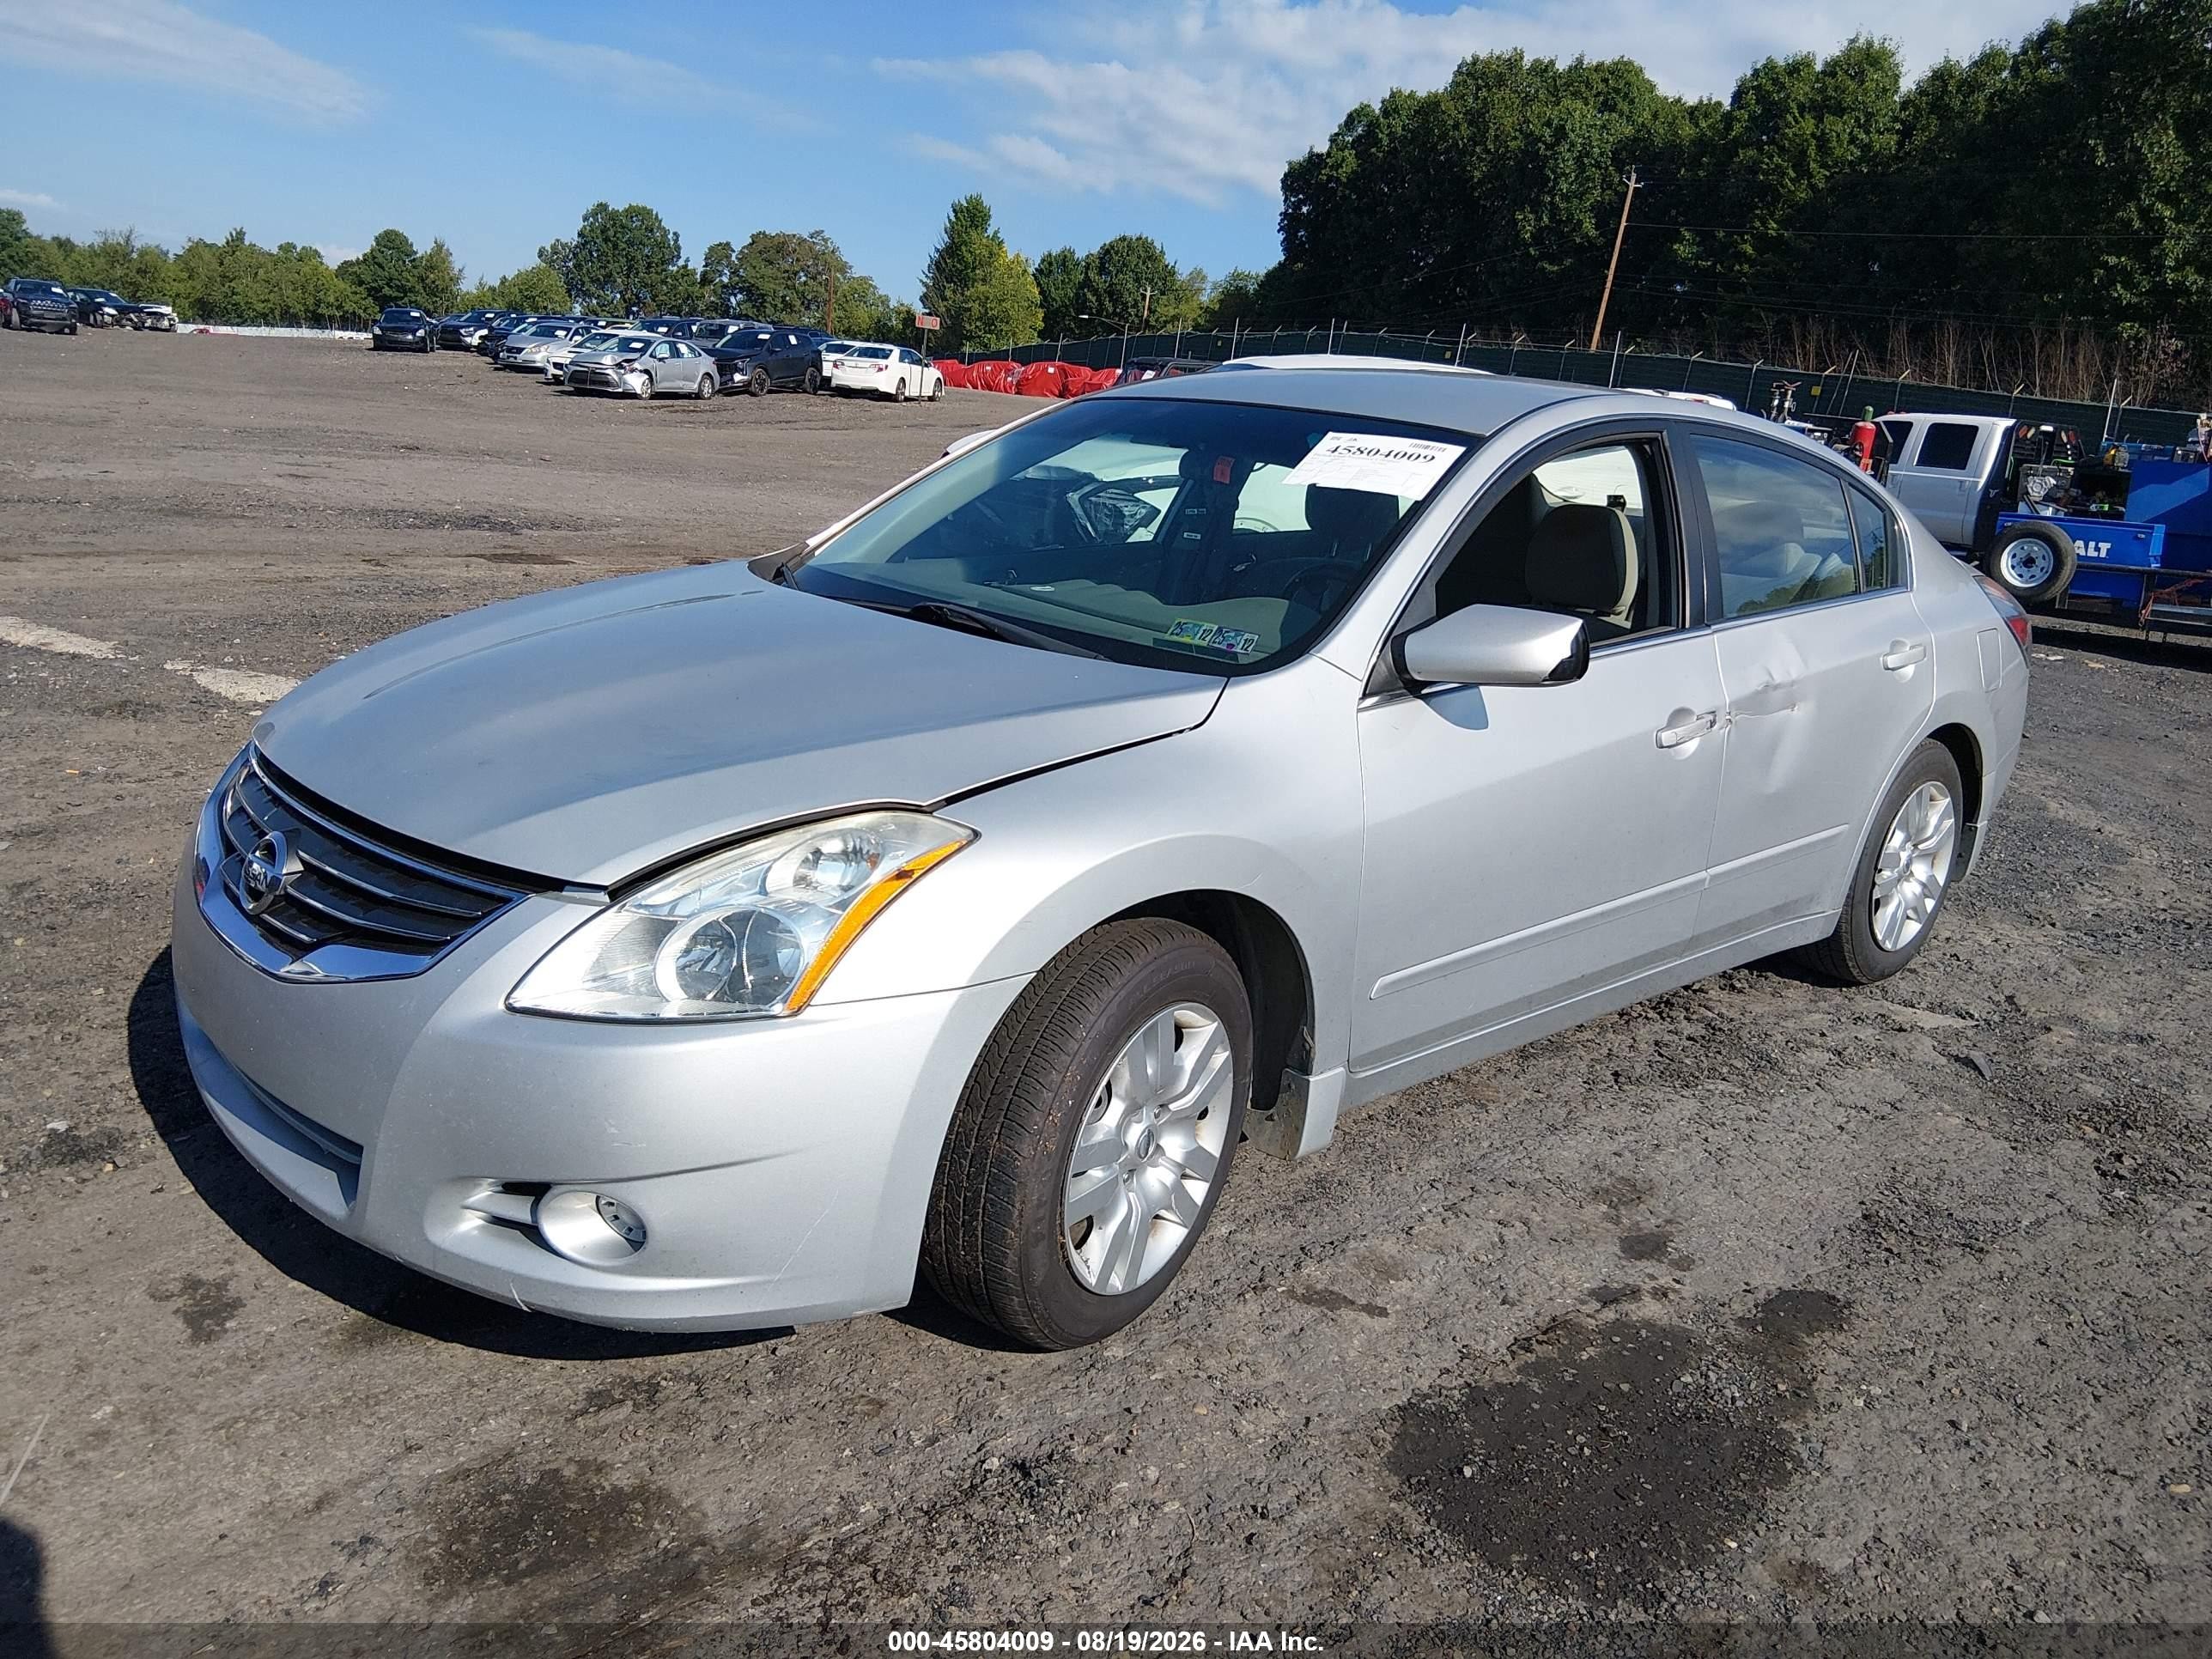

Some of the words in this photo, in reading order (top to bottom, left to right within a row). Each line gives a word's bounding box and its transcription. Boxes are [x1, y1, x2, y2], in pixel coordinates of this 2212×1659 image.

[1326, 445, 1436, 464] 45804009
[2074, 539, 2112, 558] ALT
[1170, 621, 1188, 637] 25
[1198, 628, 1213, 641] 12
[1212, 629, 1229, 645] 25
[1240, 637, 1255, 652] 12
